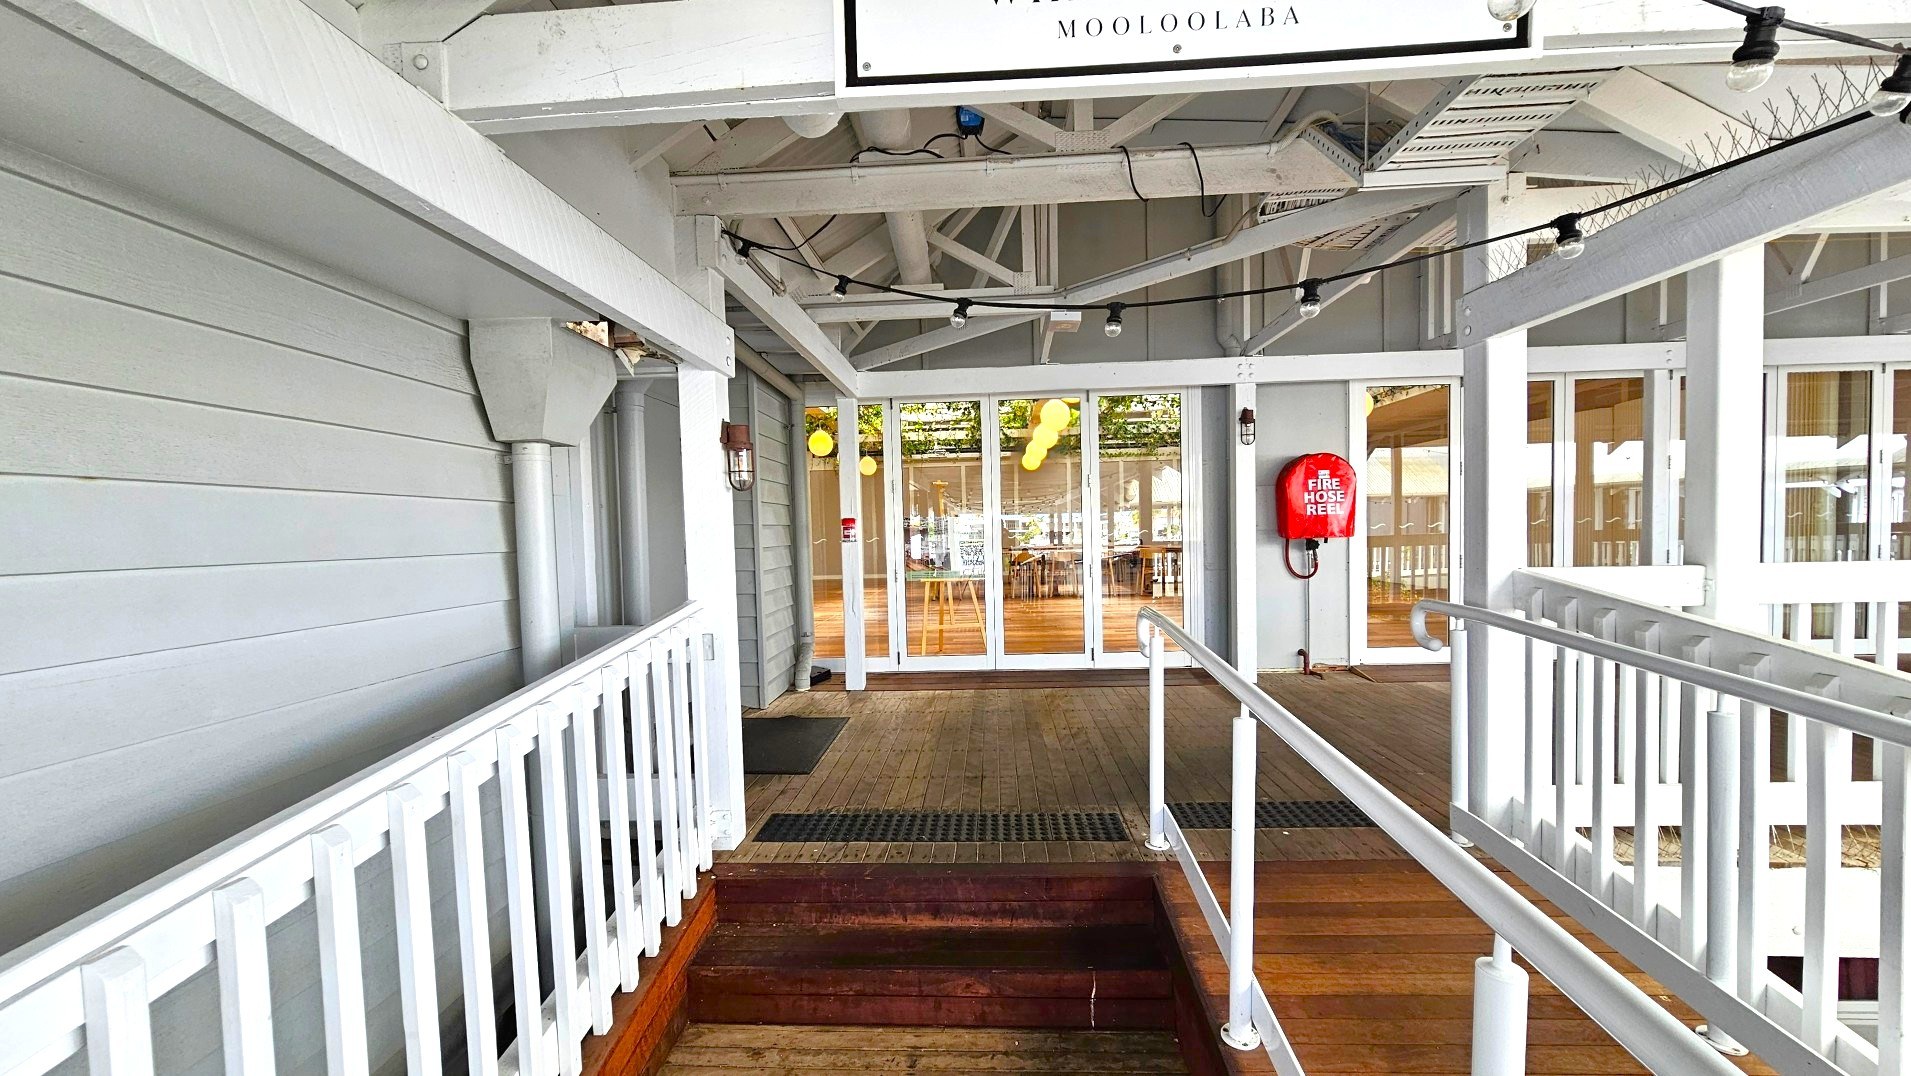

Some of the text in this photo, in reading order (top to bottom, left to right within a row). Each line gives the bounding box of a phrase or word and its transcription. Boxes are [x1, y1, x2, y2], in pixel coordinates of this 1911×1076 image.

[1058, 6, 1299, 39] MOOLOOLABA
[1308, 478, 1340, 490] FIRE
[1304, 491, 1345, 503] HOSE
[1306, 503, 1344, 515] REEL
